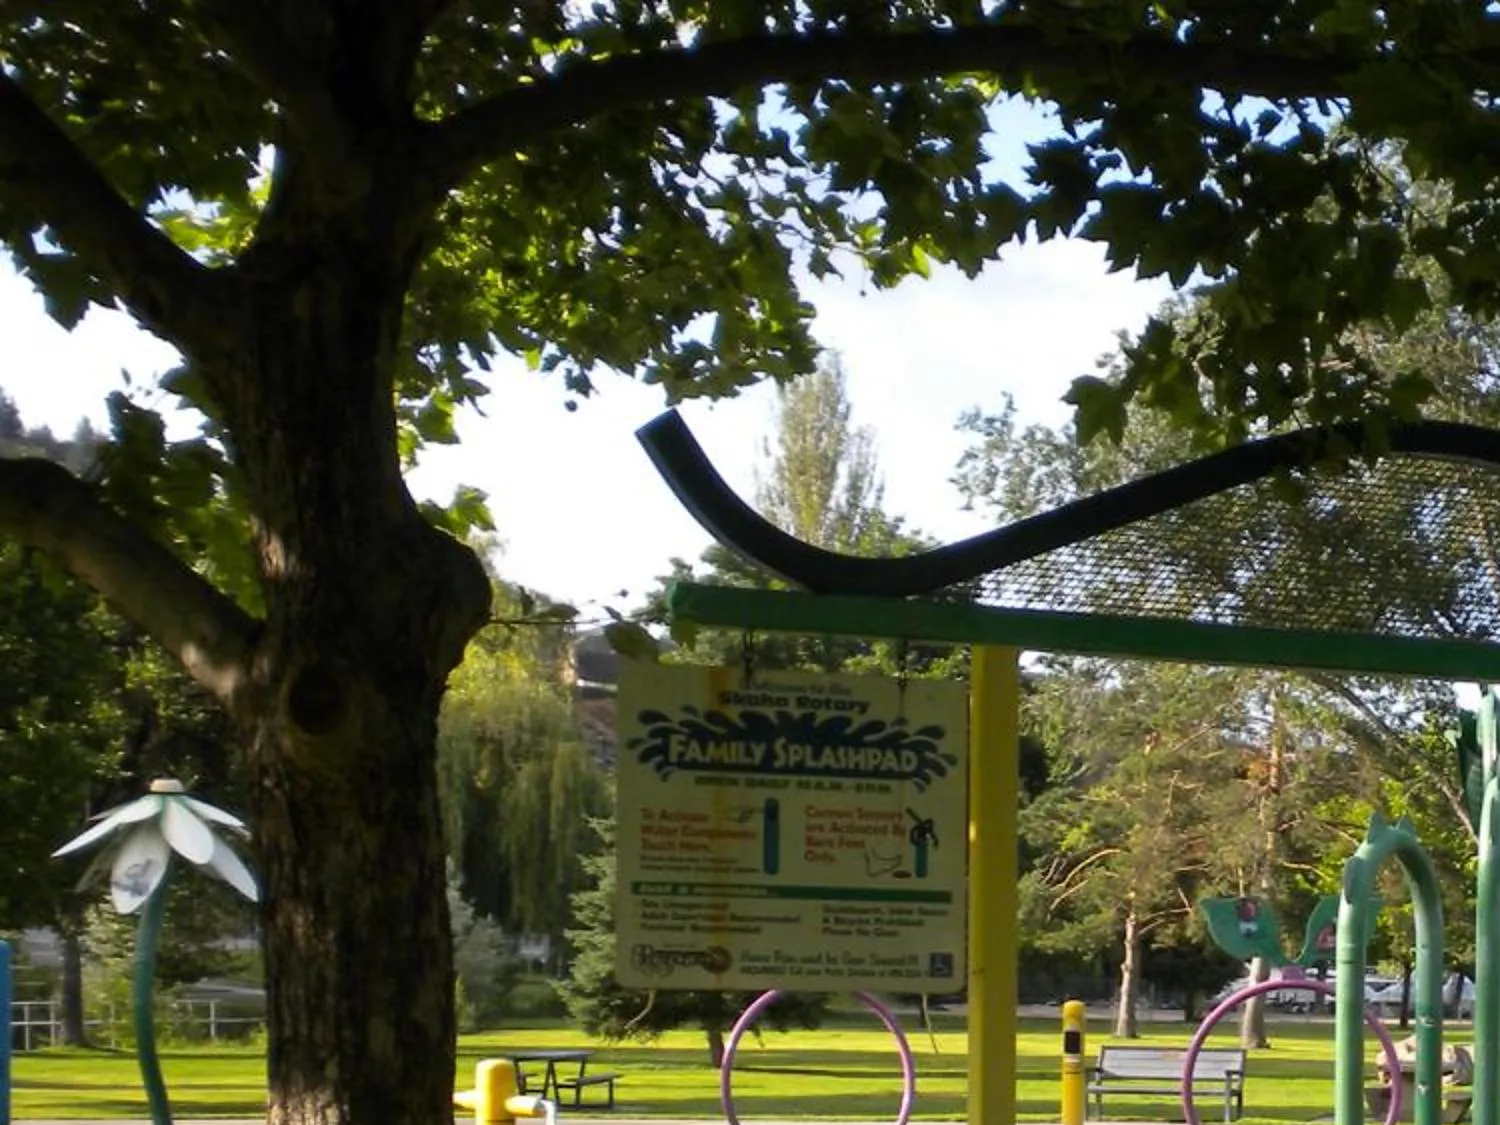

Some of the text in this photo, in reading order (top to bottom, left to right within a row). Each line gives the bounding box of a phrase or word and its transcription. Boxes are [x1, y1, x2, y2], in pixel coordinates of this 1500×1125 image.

[796, 693, 871, 714] Rotary
[668, 733, 919, 773] FAMILY SPLASHPAD
